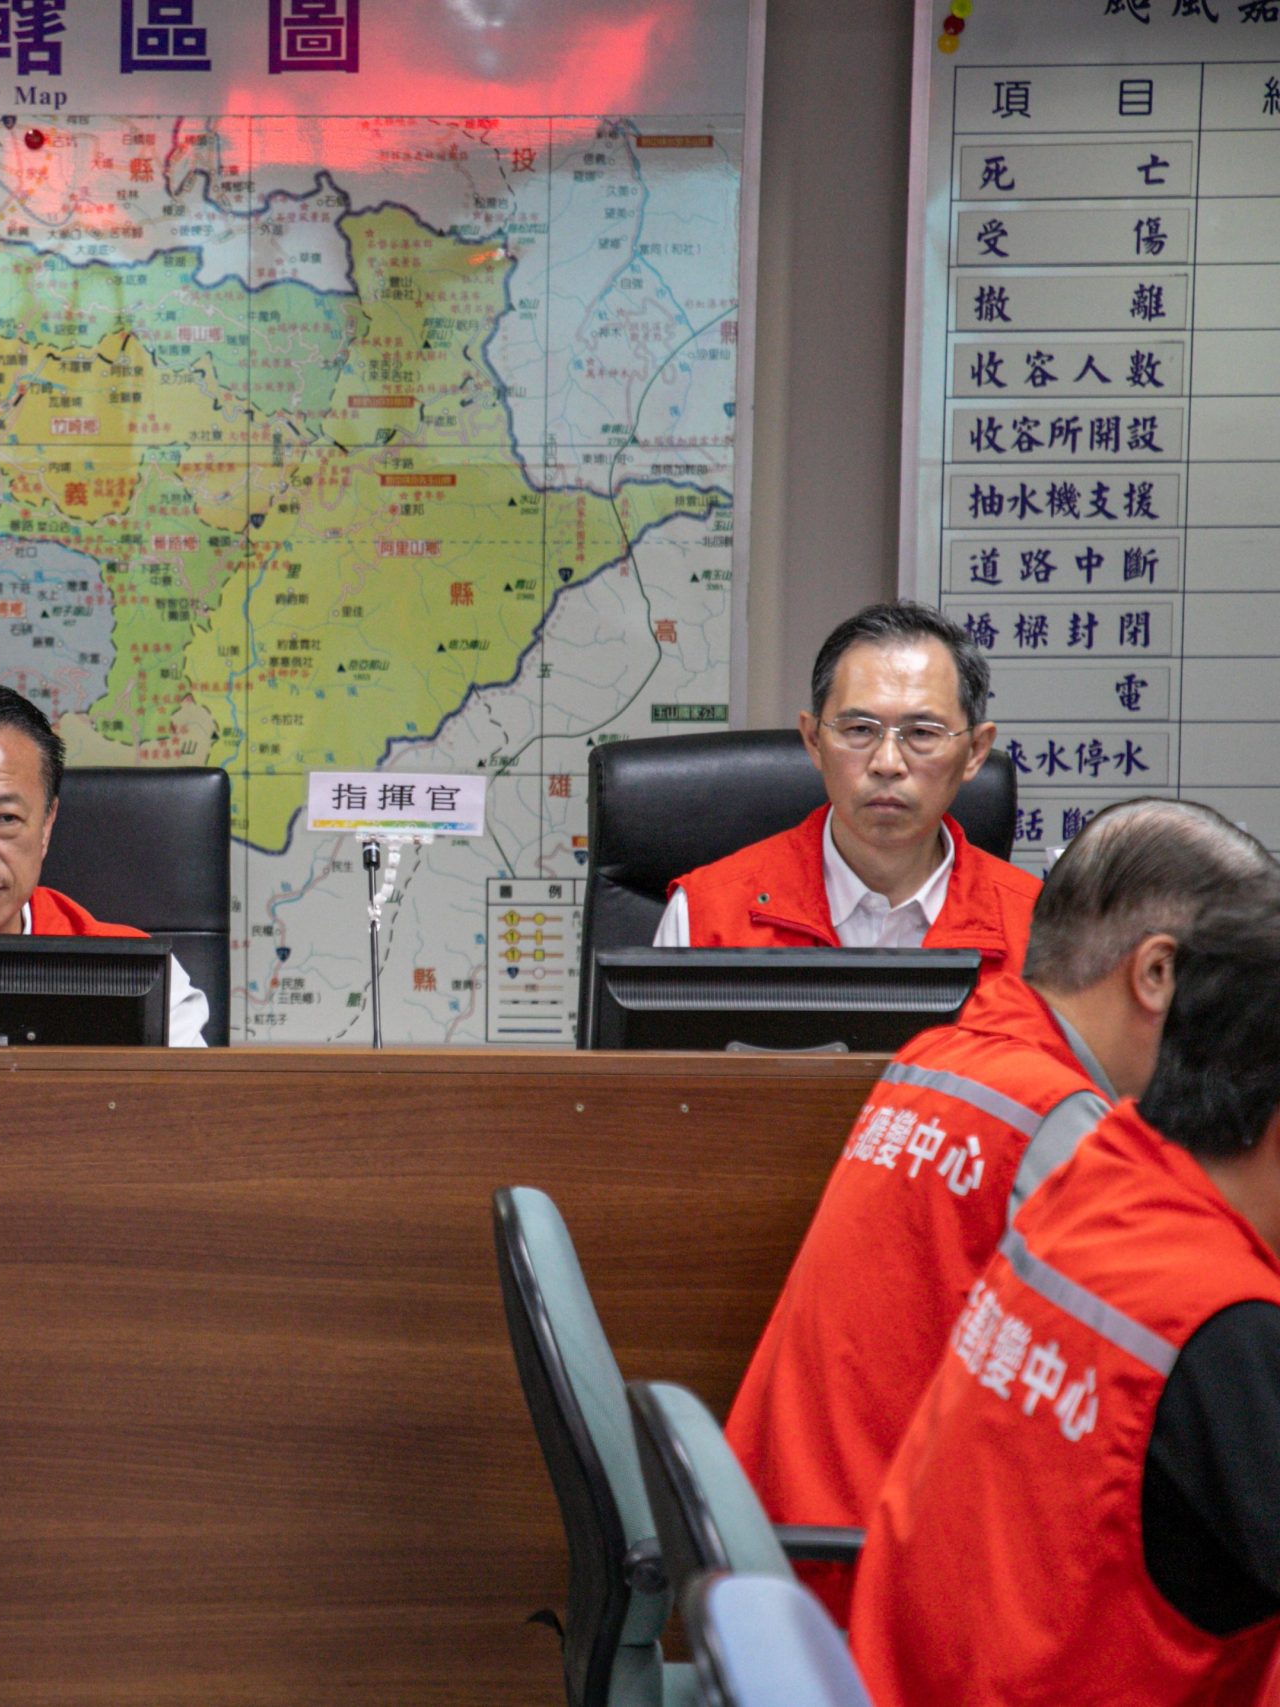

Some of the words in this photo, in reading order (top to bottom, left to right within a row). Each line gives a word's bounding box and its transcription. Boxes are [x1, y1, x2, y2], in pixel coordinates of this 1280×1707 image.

[14, 86, 68, 110] Map
[992, 79, 1154, 118] 項目
[979, 153, 1170, 190] 死亡
[976, 216, 1168, 257] 受傷
[974, 283, 1166, 322] 撤離
[970, 349, 1164, 389] 收容人數
[969, 414, 1163, 454] 收容所開設
[968, 480, 1160, 520] 抽水機支援
[969, 546, 1160, 585] 道路中斷
[963, 610, 1151, 649] 橋樑封閉
[331, 783, 462, 813] 指揮官
